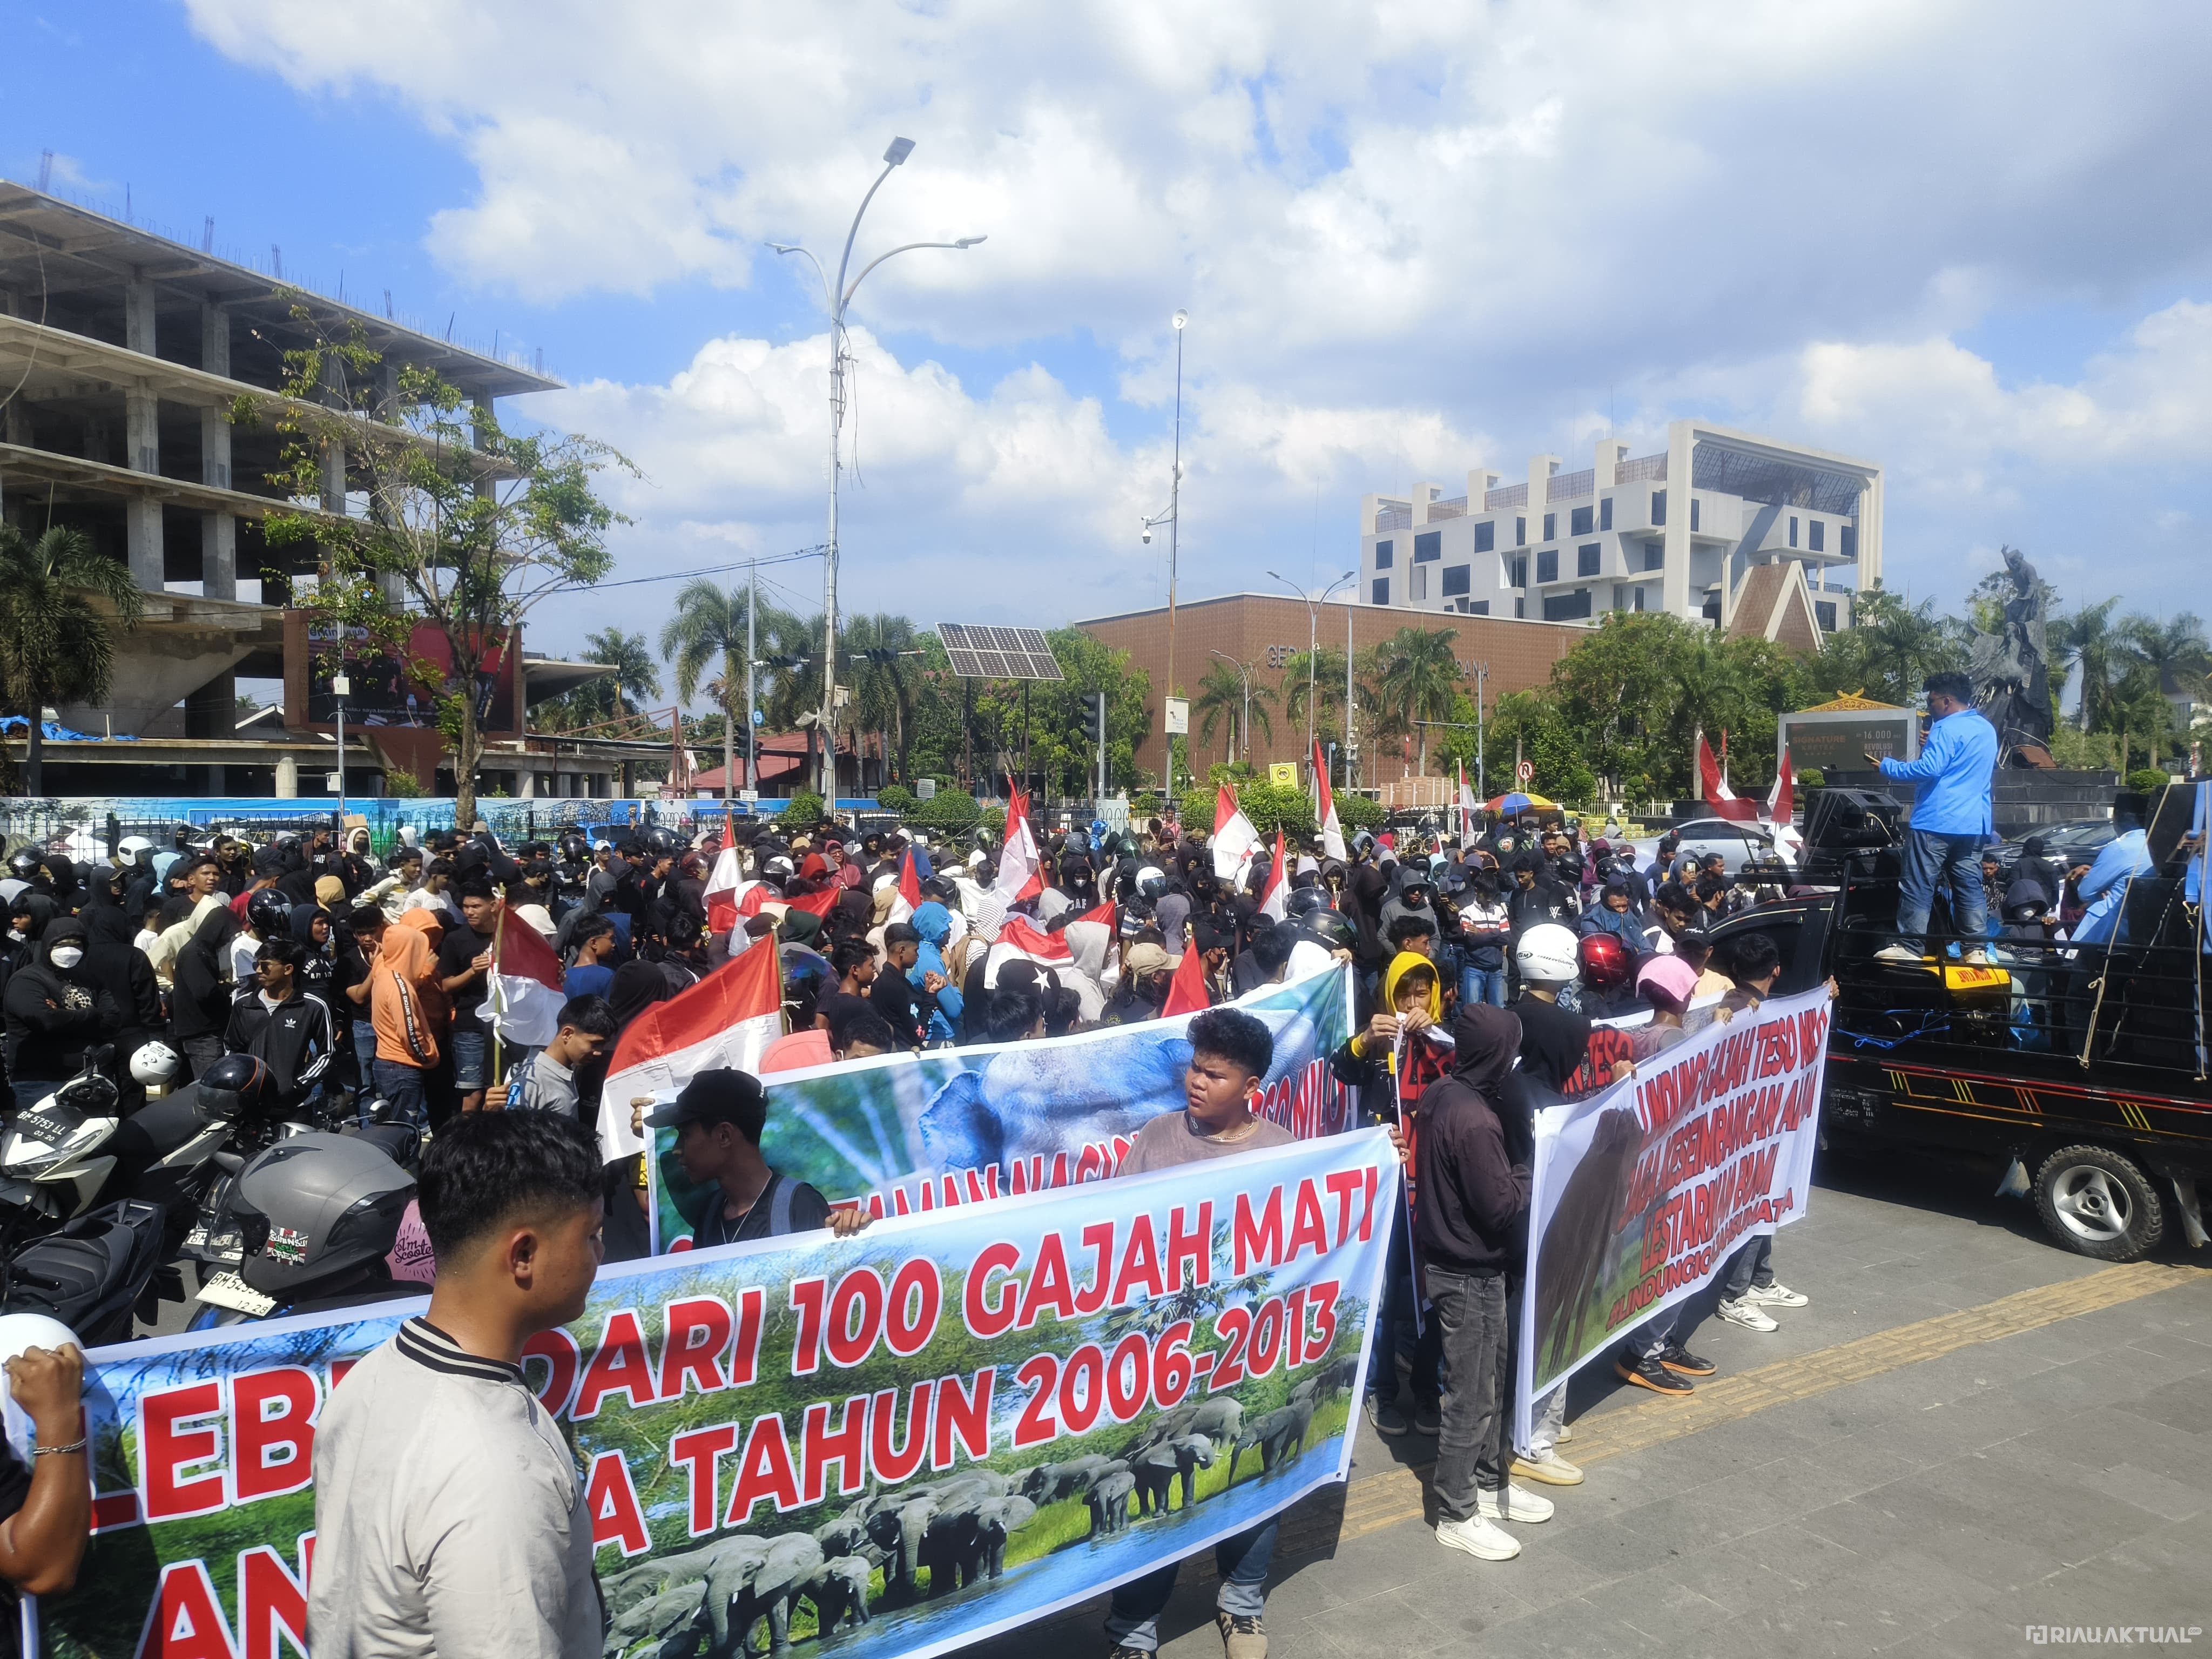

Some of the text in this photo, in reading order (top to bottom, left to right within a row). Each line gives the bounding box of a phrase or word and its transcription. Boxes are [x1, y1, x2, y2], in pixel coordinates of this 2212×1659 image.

[1792, 735, 1846, 744] SIGNATURE
[1864, 730, 1892, 739] 16.000
[1752, 1014, 1798, 1081] TESO
[30, 1115, 54, 1129] 5753
[52, 1124, 66, 1135] LL
[271, 1249, 299, 1262] CREW
[394, 1239, 433, 1263] Scoote
[210, 1273, 232, 1286] BM
[520, 1283, 766, 1422] DARI
[789, 1255, 943, 1377] 100
[962, 1196, 1216, 1340] GAJAH
[1230, 1164, 1379, 1278] MATI
[669, 1364, 997, 1538] TAHUN
[1010, 1278, 1342, 1453] 2006-2013
